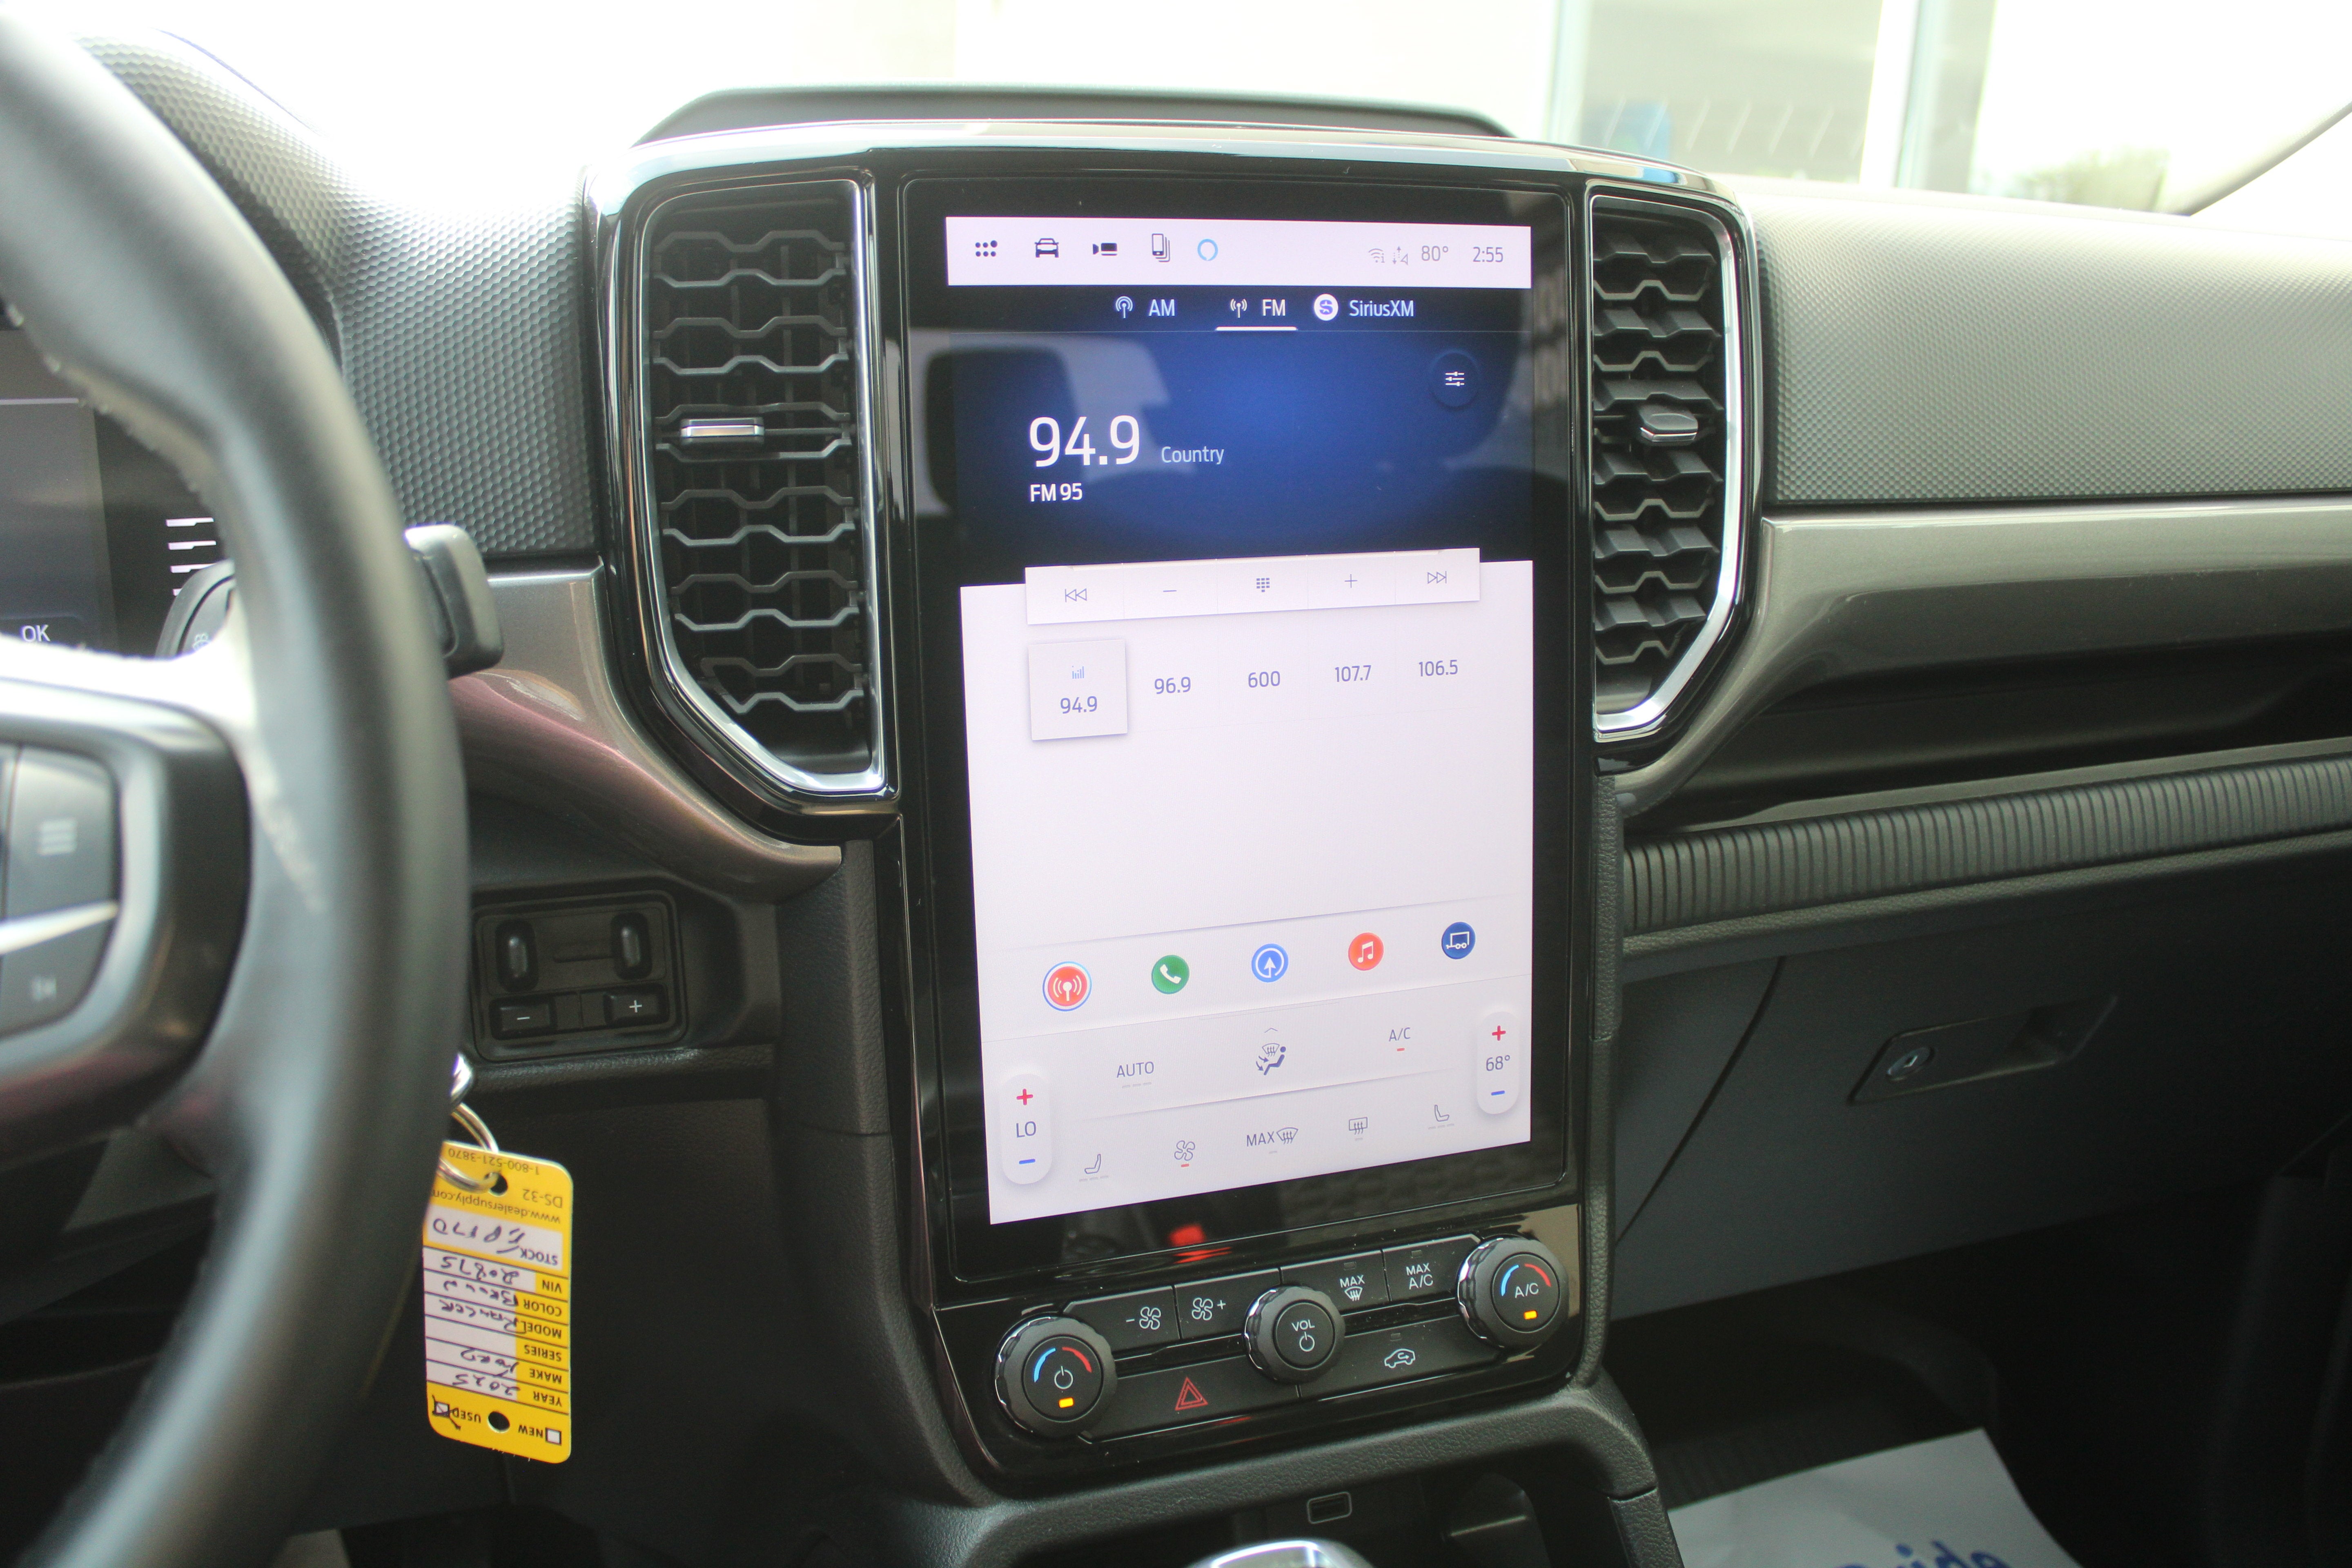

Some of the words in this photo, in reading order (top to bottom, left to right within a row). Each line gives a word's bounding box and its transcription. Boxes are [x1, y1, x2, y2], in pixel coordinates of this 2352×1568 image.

[1421, 245, 1448, 261] 80°
[1473, 247, 1503, 262] 2:55
[1149, 299, 1175, 316] AM
[1263, 299, 1285, 316] FM
[1350, 300, 1413, 316] SiriusXM
[1030, 415, 1139, 467] 94.9
[1161, 446, 1224, 464] Country
[1031, 484, 1056, 501] FM
[1060, 483, 1082, 500] 95
[22, 625, 50, 643] OK
[1335, 665, 1371, 682] 107.7
[1419, 660, 1458, 677] 106.5
[1155, 677, 1191, 694] 96.9
[1248, 671, 1280, 688] 600
[1060, 696, 1097, 714] 94.9
[1389, 1027, 1410, 1041] A/C
[1117, 1062, 1154, 1078] AUTO
[1486, 1055, 1510, 1071] 68°
[1016, 1121, 1036, 1138] LO
[1247, 1131, 1274, 1147] MAX
[448, 1148, 539, 1175] 1-800-521-3870
[522, 1189, 563, 1209] DS-32
[520, 1248, 558, 1265] STOCK
[1406, 1263, 1431, 1276] MAX
[542, 1279, 562, 1293] VIN
[1340, 1275, 1365, 1288] MAX
[1409, 1274, 1434, 1290] A/C
[1515, 1283, 1539, 1298] A/C
[524, 1299, 562, 1316] COLOR
[521, 1321, 561, 1339] MODEL
[1292, 1319, 1315, 1331] VOL
[524, 1345, 562, 1361] SERIES
[530, 1369, 562, 1383] MAKE
[533, 1391, 562, 1407] YEAR
[452, 1408, 481, 1423] USED
[518, 1425, 543, 1438] NEW
